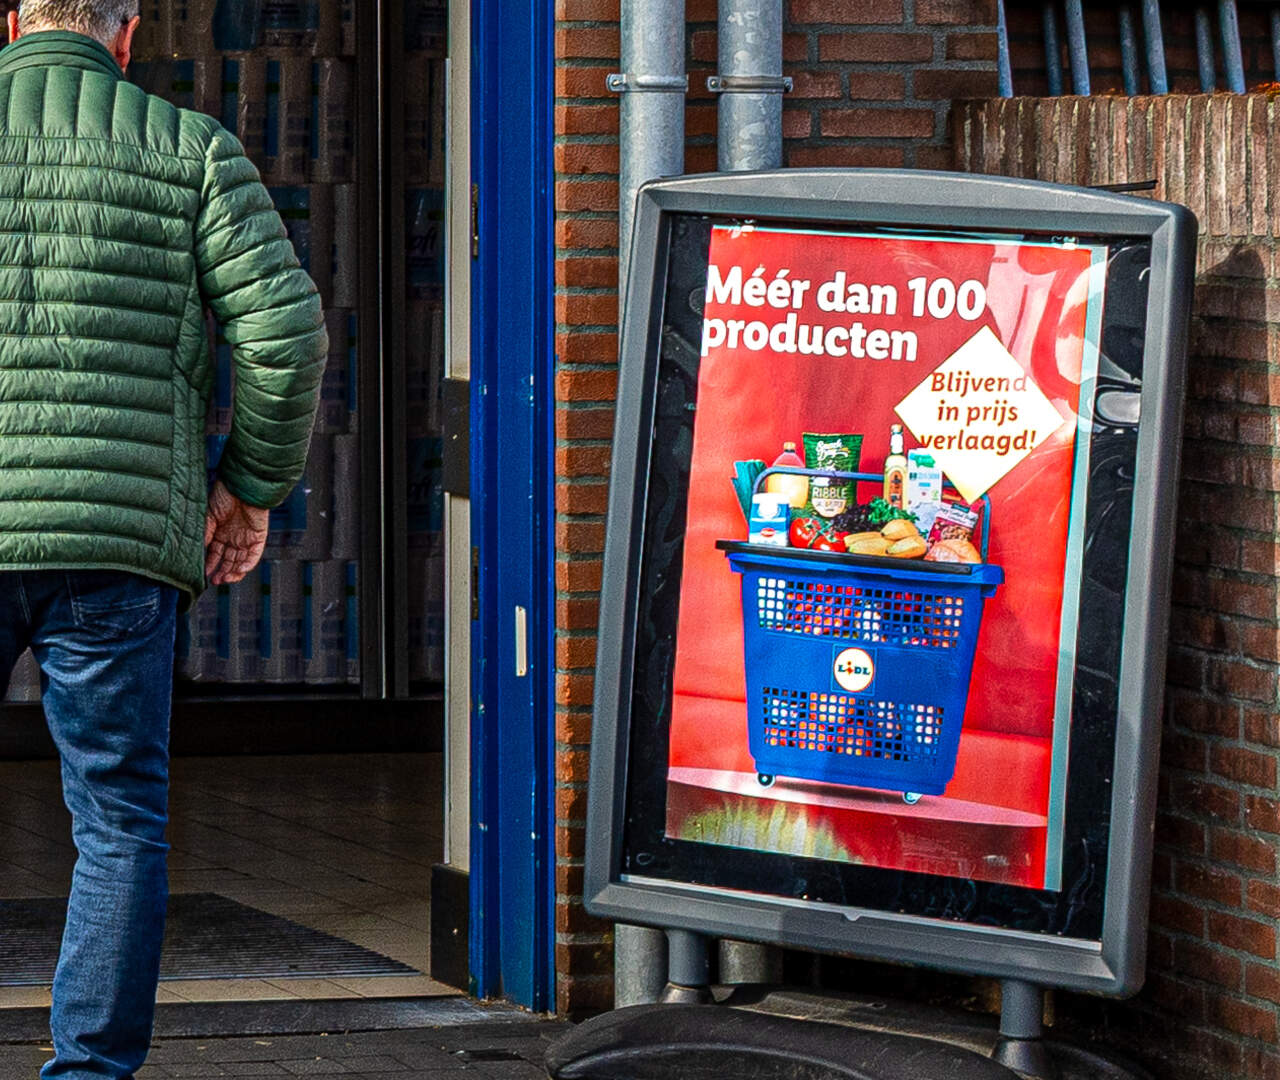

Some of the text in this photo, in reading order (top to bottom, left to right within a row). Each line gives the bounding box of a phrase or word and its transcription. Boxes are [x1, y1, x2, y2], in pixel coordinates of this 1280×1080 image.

[705, 264, 987, 321] Méér dan 100
[701, 312, 919, 362] producten
[931, 372, 1028, 398] Blijvend
[938, 400, 1019, 427] in prijs
[920, 430, 1037, 455] verlaagd!
